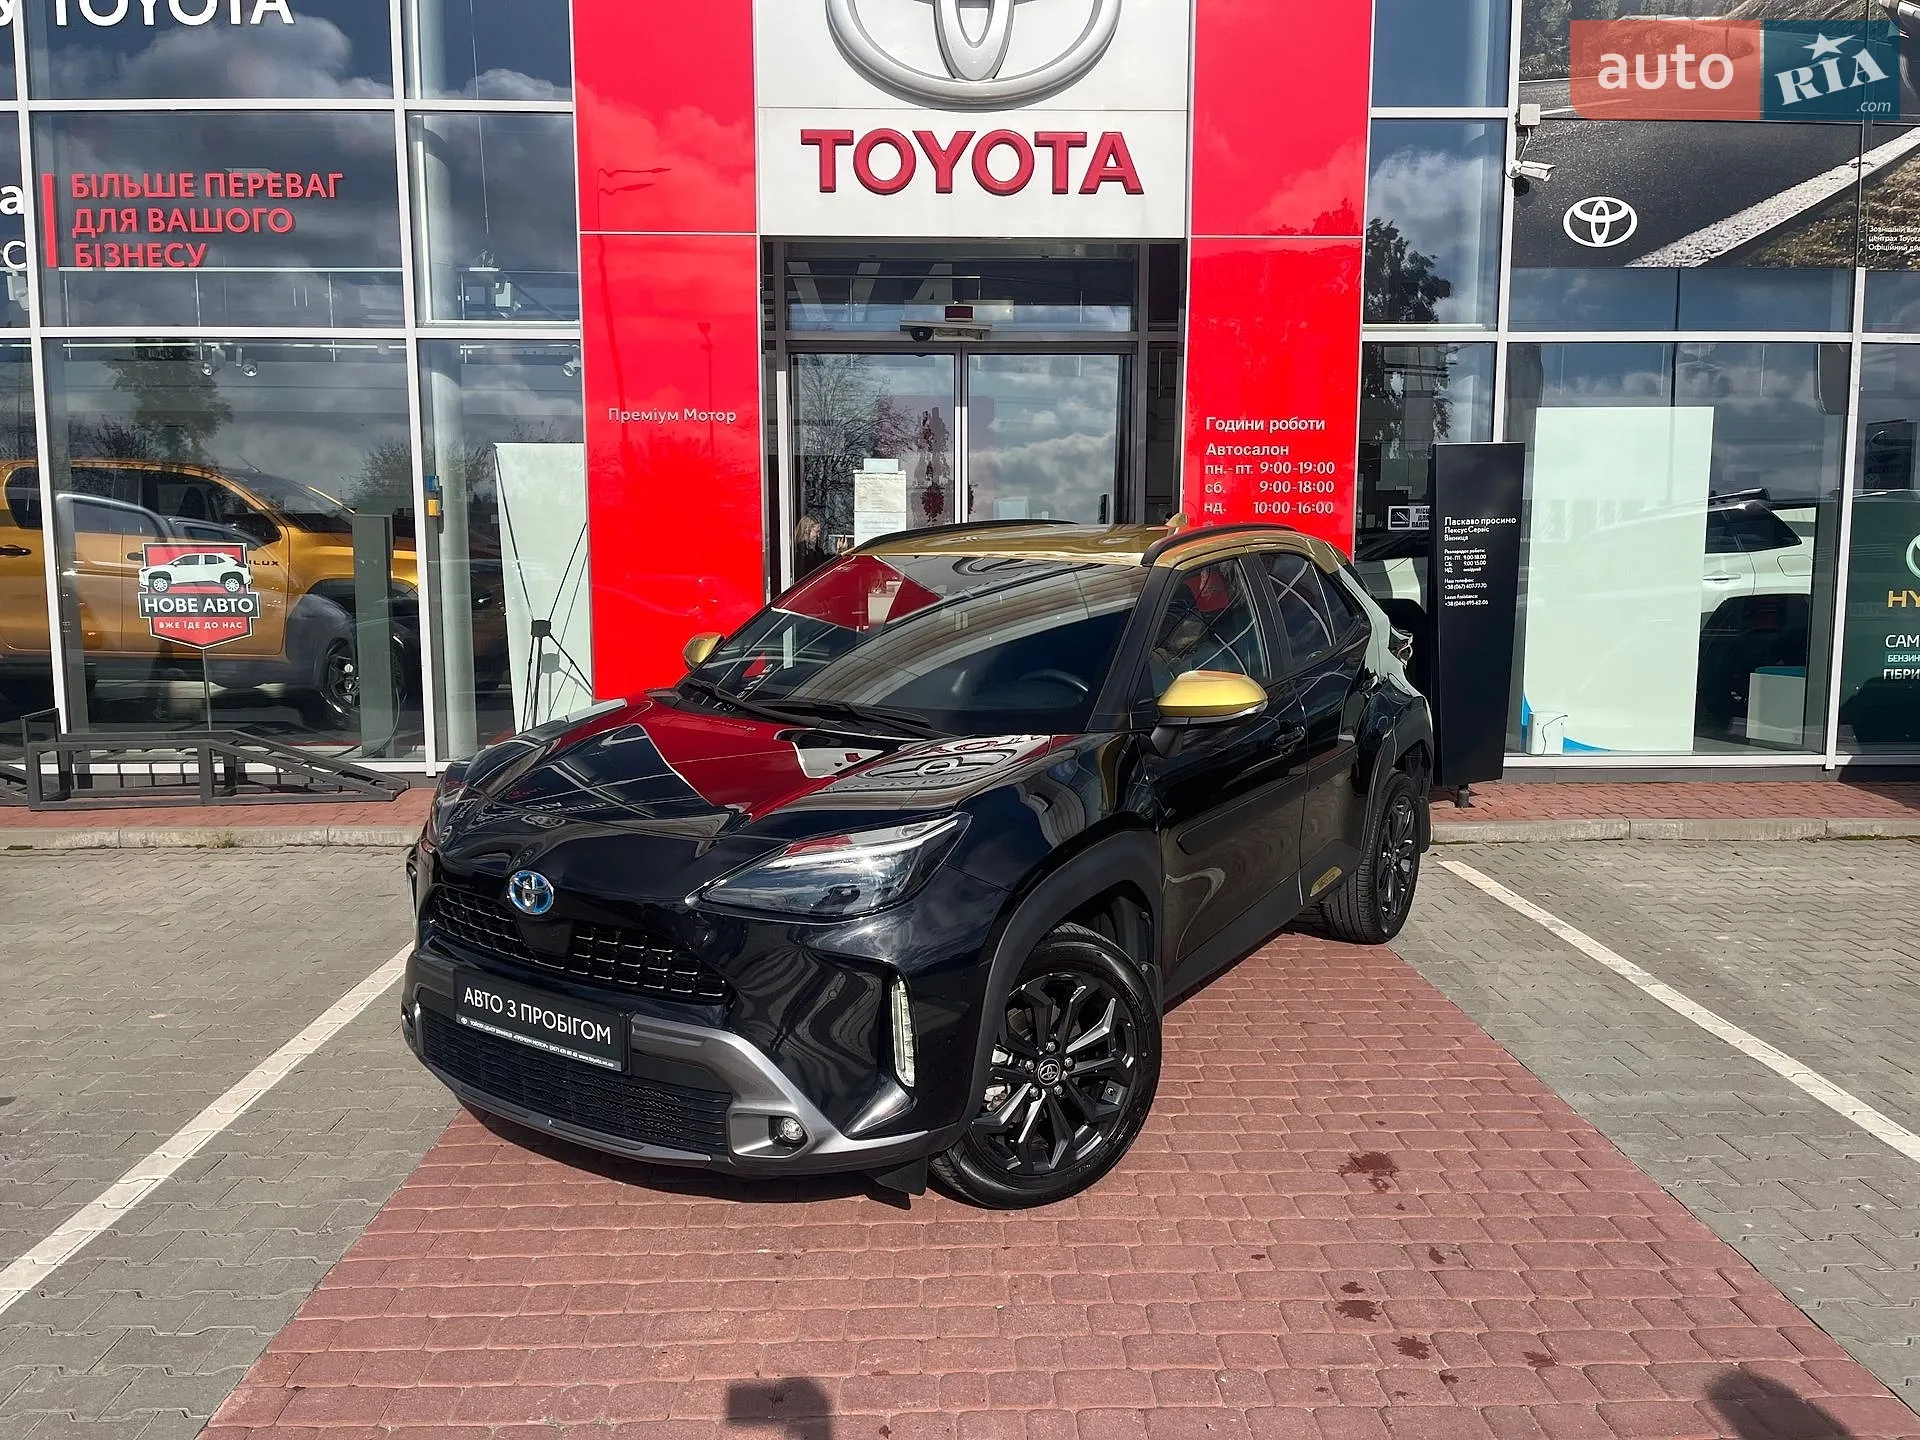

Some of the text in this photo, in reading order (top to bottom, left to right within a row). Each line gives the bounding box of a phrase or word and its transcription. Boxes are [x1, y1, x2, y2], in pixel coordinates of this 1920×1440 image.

[800, 128, 1144, 195] TOYOTA
[71, 172, 344, 199] БІЛЬШЕ ПЕРЕВАГ
[71, 207, 294, 238] ДЛЯ ВАШОГО
[75, 242, 208, 268] БІЗНЕСУ
[608, 407, 737, 425] Преміум Мотор
[1205, 416, 1326, 434] Години роботи
[1205, 443, 1289, 456] Автосалон
[1259, 461, 1335, 475] 9:00-19:00
[1205, 480, 1335, 494] сб. 9:00-18:00
[1203, 501, 1334, 515] нд. 10:00-16:00
[144, 597, 254, 613] НОВЕ АВТО
[184, 621, 201, 630] ЇДЕ
[204, 621, 219, 630] ДО
[222, 621, 243, 629] НАС
[463, 986, 611, 1045] АВТО З ПРОБІГОМ
